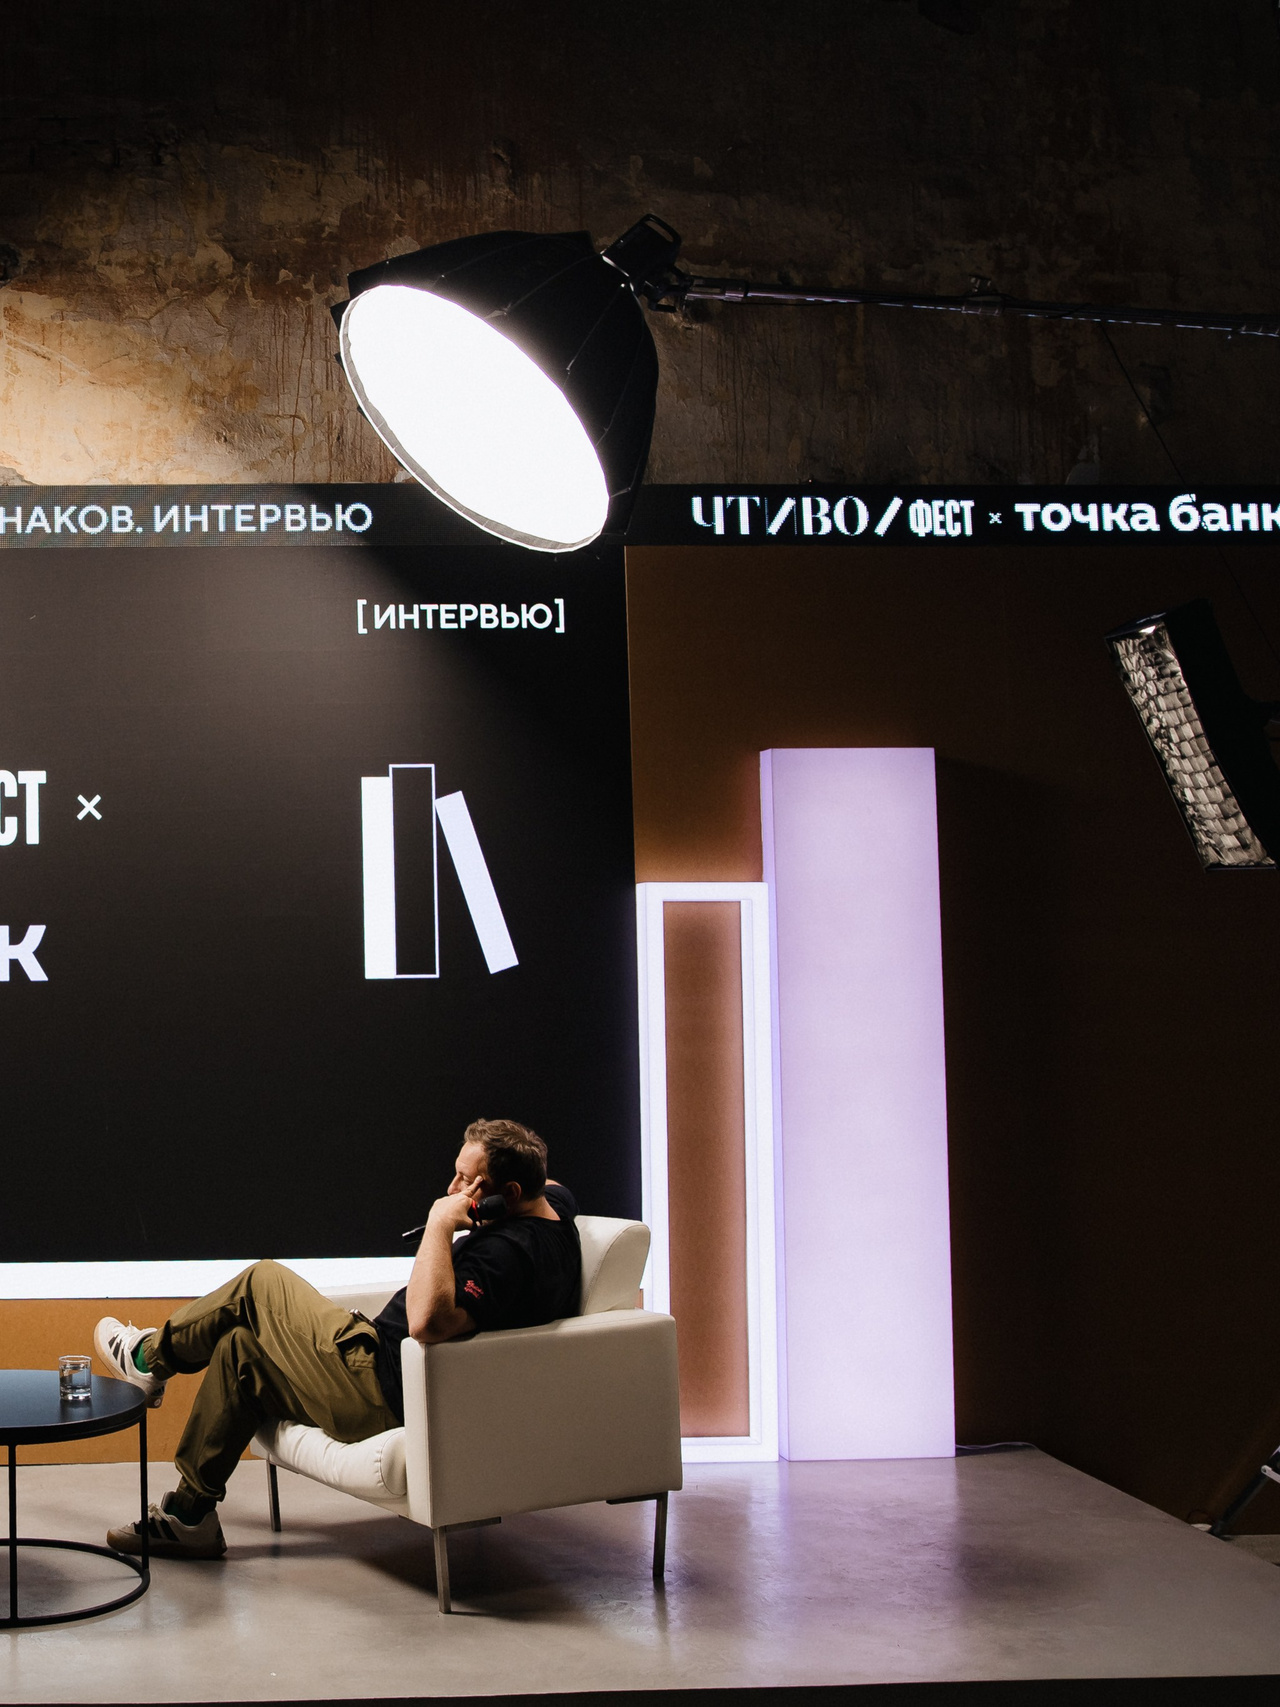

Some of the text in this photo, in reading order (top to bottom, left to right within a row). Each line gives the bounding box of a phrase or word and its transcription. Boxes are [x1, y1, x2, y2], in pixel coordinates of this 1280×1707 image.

[154, 502, 373, 534] ИНТЕРВЬЮ
[1014, 502, 1161, 532] точка
[1168, 493, 1280, 532] банк
[356, 598, 565, 635] [ИНТЕРВЬЮ]
